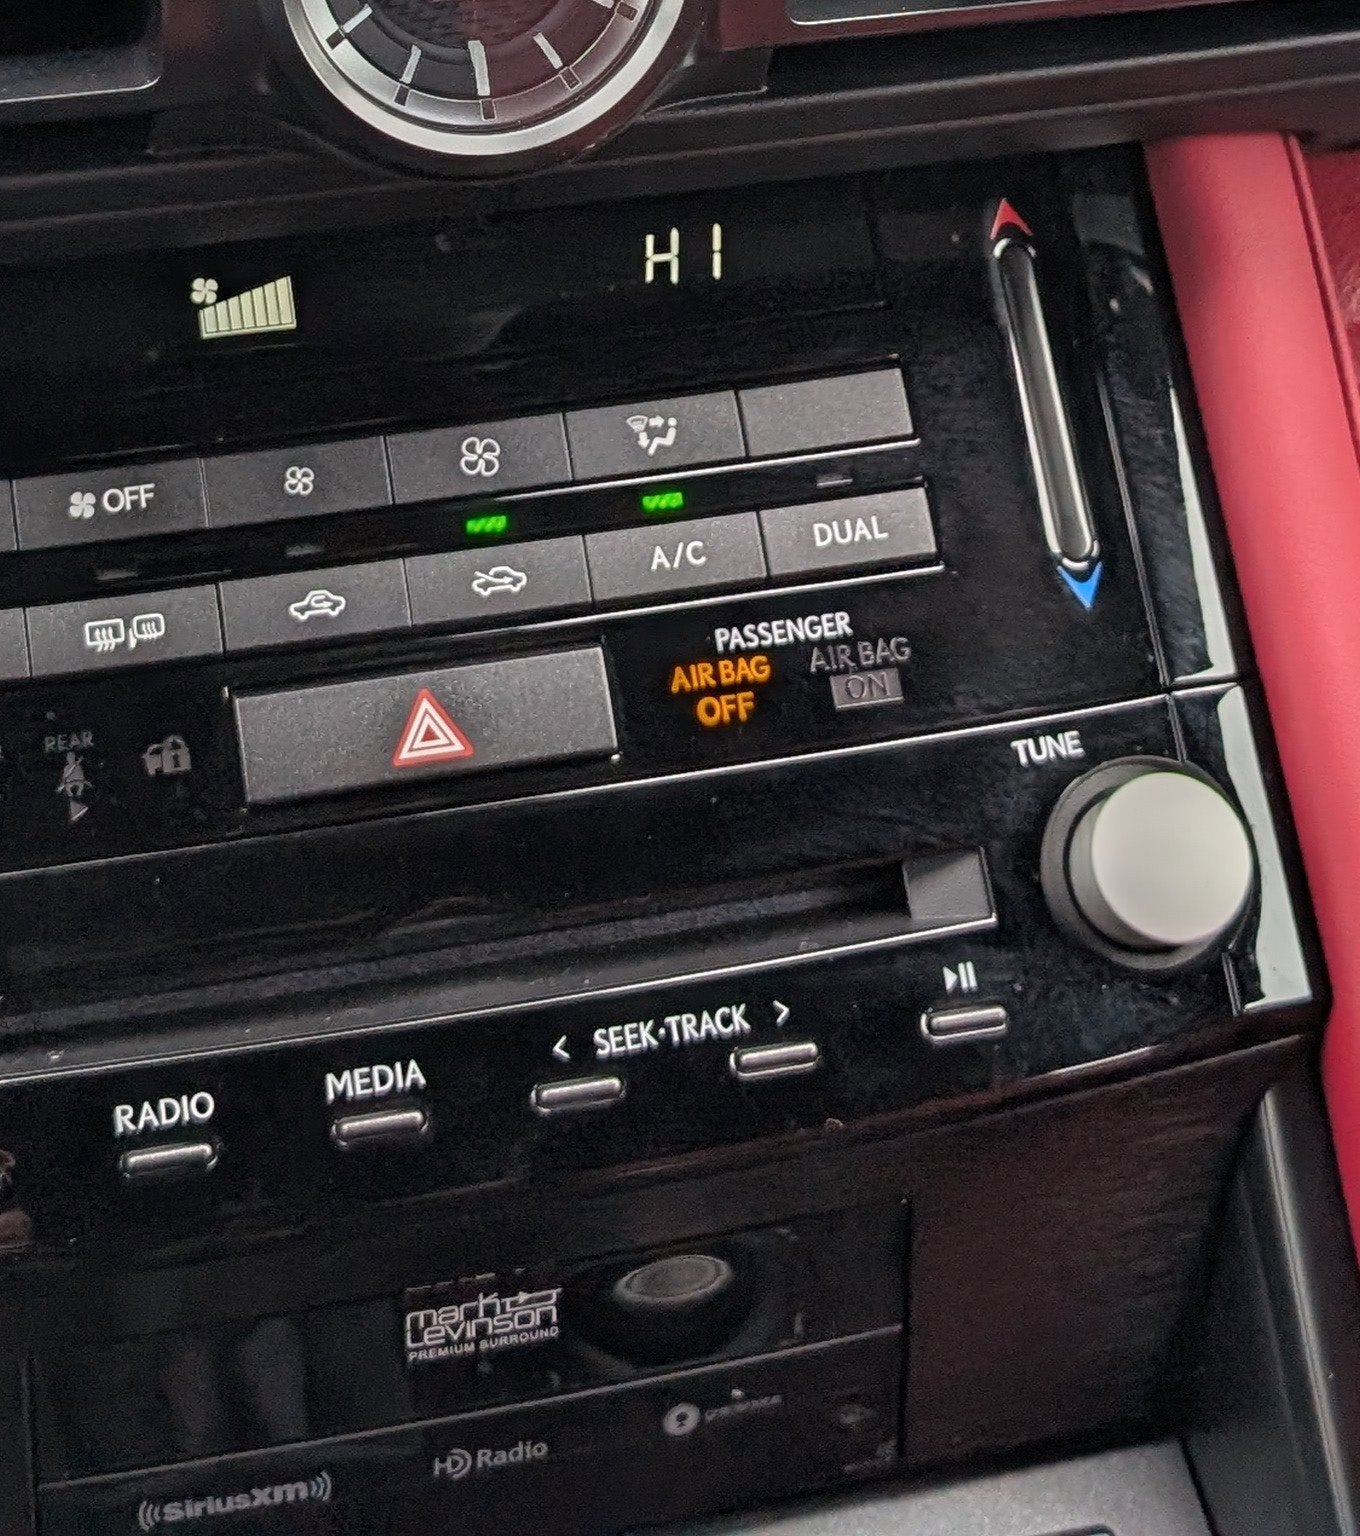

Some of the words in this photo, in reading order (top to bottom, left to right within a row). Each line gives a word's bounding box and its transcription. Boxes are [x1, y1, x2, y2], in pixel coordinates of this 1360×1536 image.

[645, 223, 722, 284] HI
[102, 482, 156, 514] OFF
[812, 515, 889, 547] DUAL
[650, 540, 707, 571] A/C
[714, 611, 853, 654] PASSENGER
[809, 644, 857, 673] AIR
[857, 636, 912, 666] BAG
[671, 662, 717, 693] AIR
[718, 655, 771, 686] BAG
[845, 672, 891, 699] ON
[696, 690, 755, 727] OFF
[44, 730, 95, 754] REAR
[1012, 731, 1083, 761] TUNE
[325, 1059, 426, 1104] MEDIA
[114, 1091, 215, 1136] RADIO
[408, 1341, 475, 1362] PREMIUM
[479, 1325, 560, 1350] SURROUND
[476, 1440, 548, 1468] Radio
